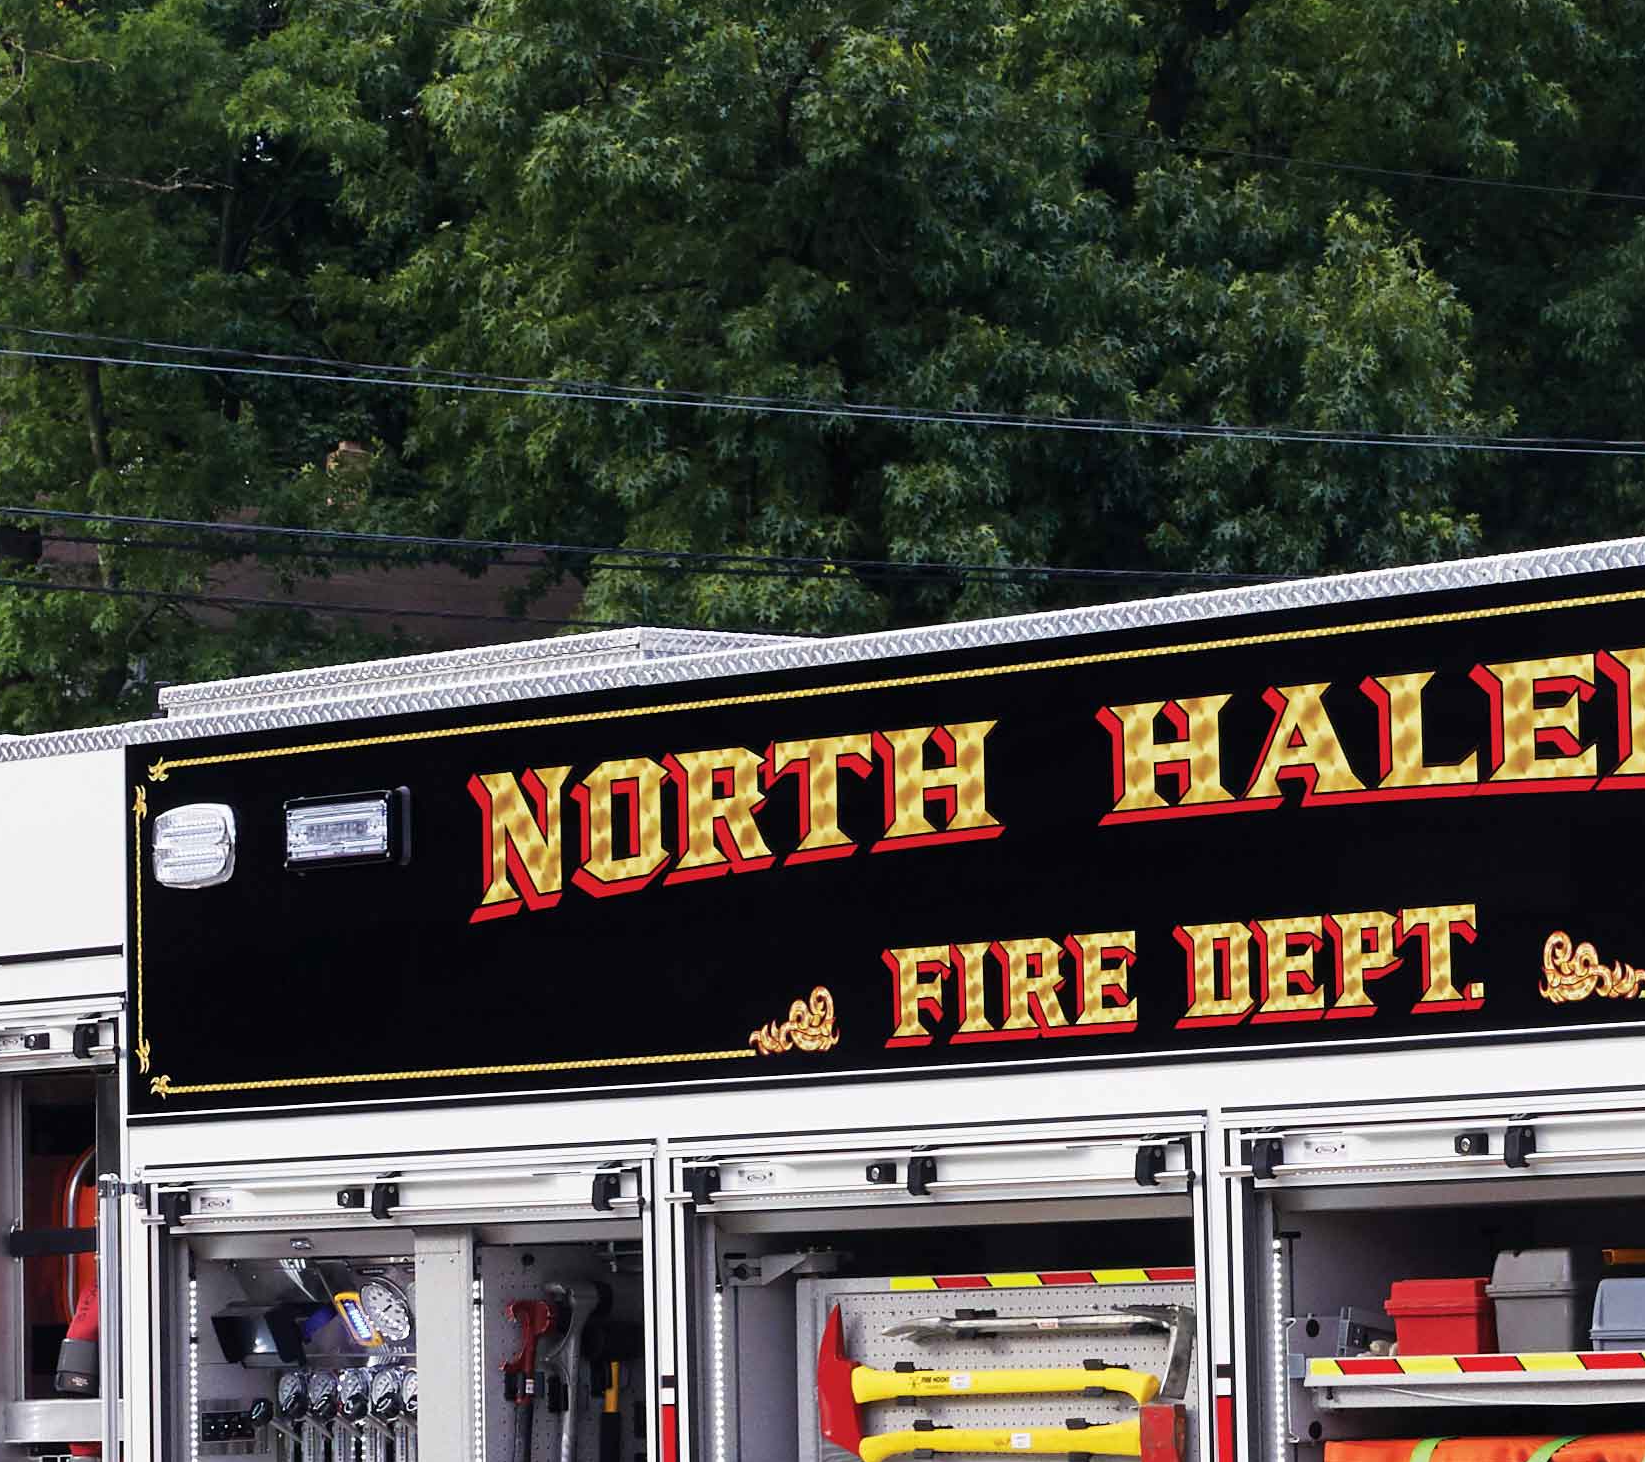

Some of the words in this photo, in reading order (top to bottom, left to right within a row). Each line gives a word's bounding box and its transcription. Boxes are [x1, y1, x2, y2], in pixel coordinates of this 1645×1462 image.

[468, 721, 1005, 924] NORTH
[882, 929, 1138, 1047] FIRE
[1173, 903, 1485, 1030] DEPT.
